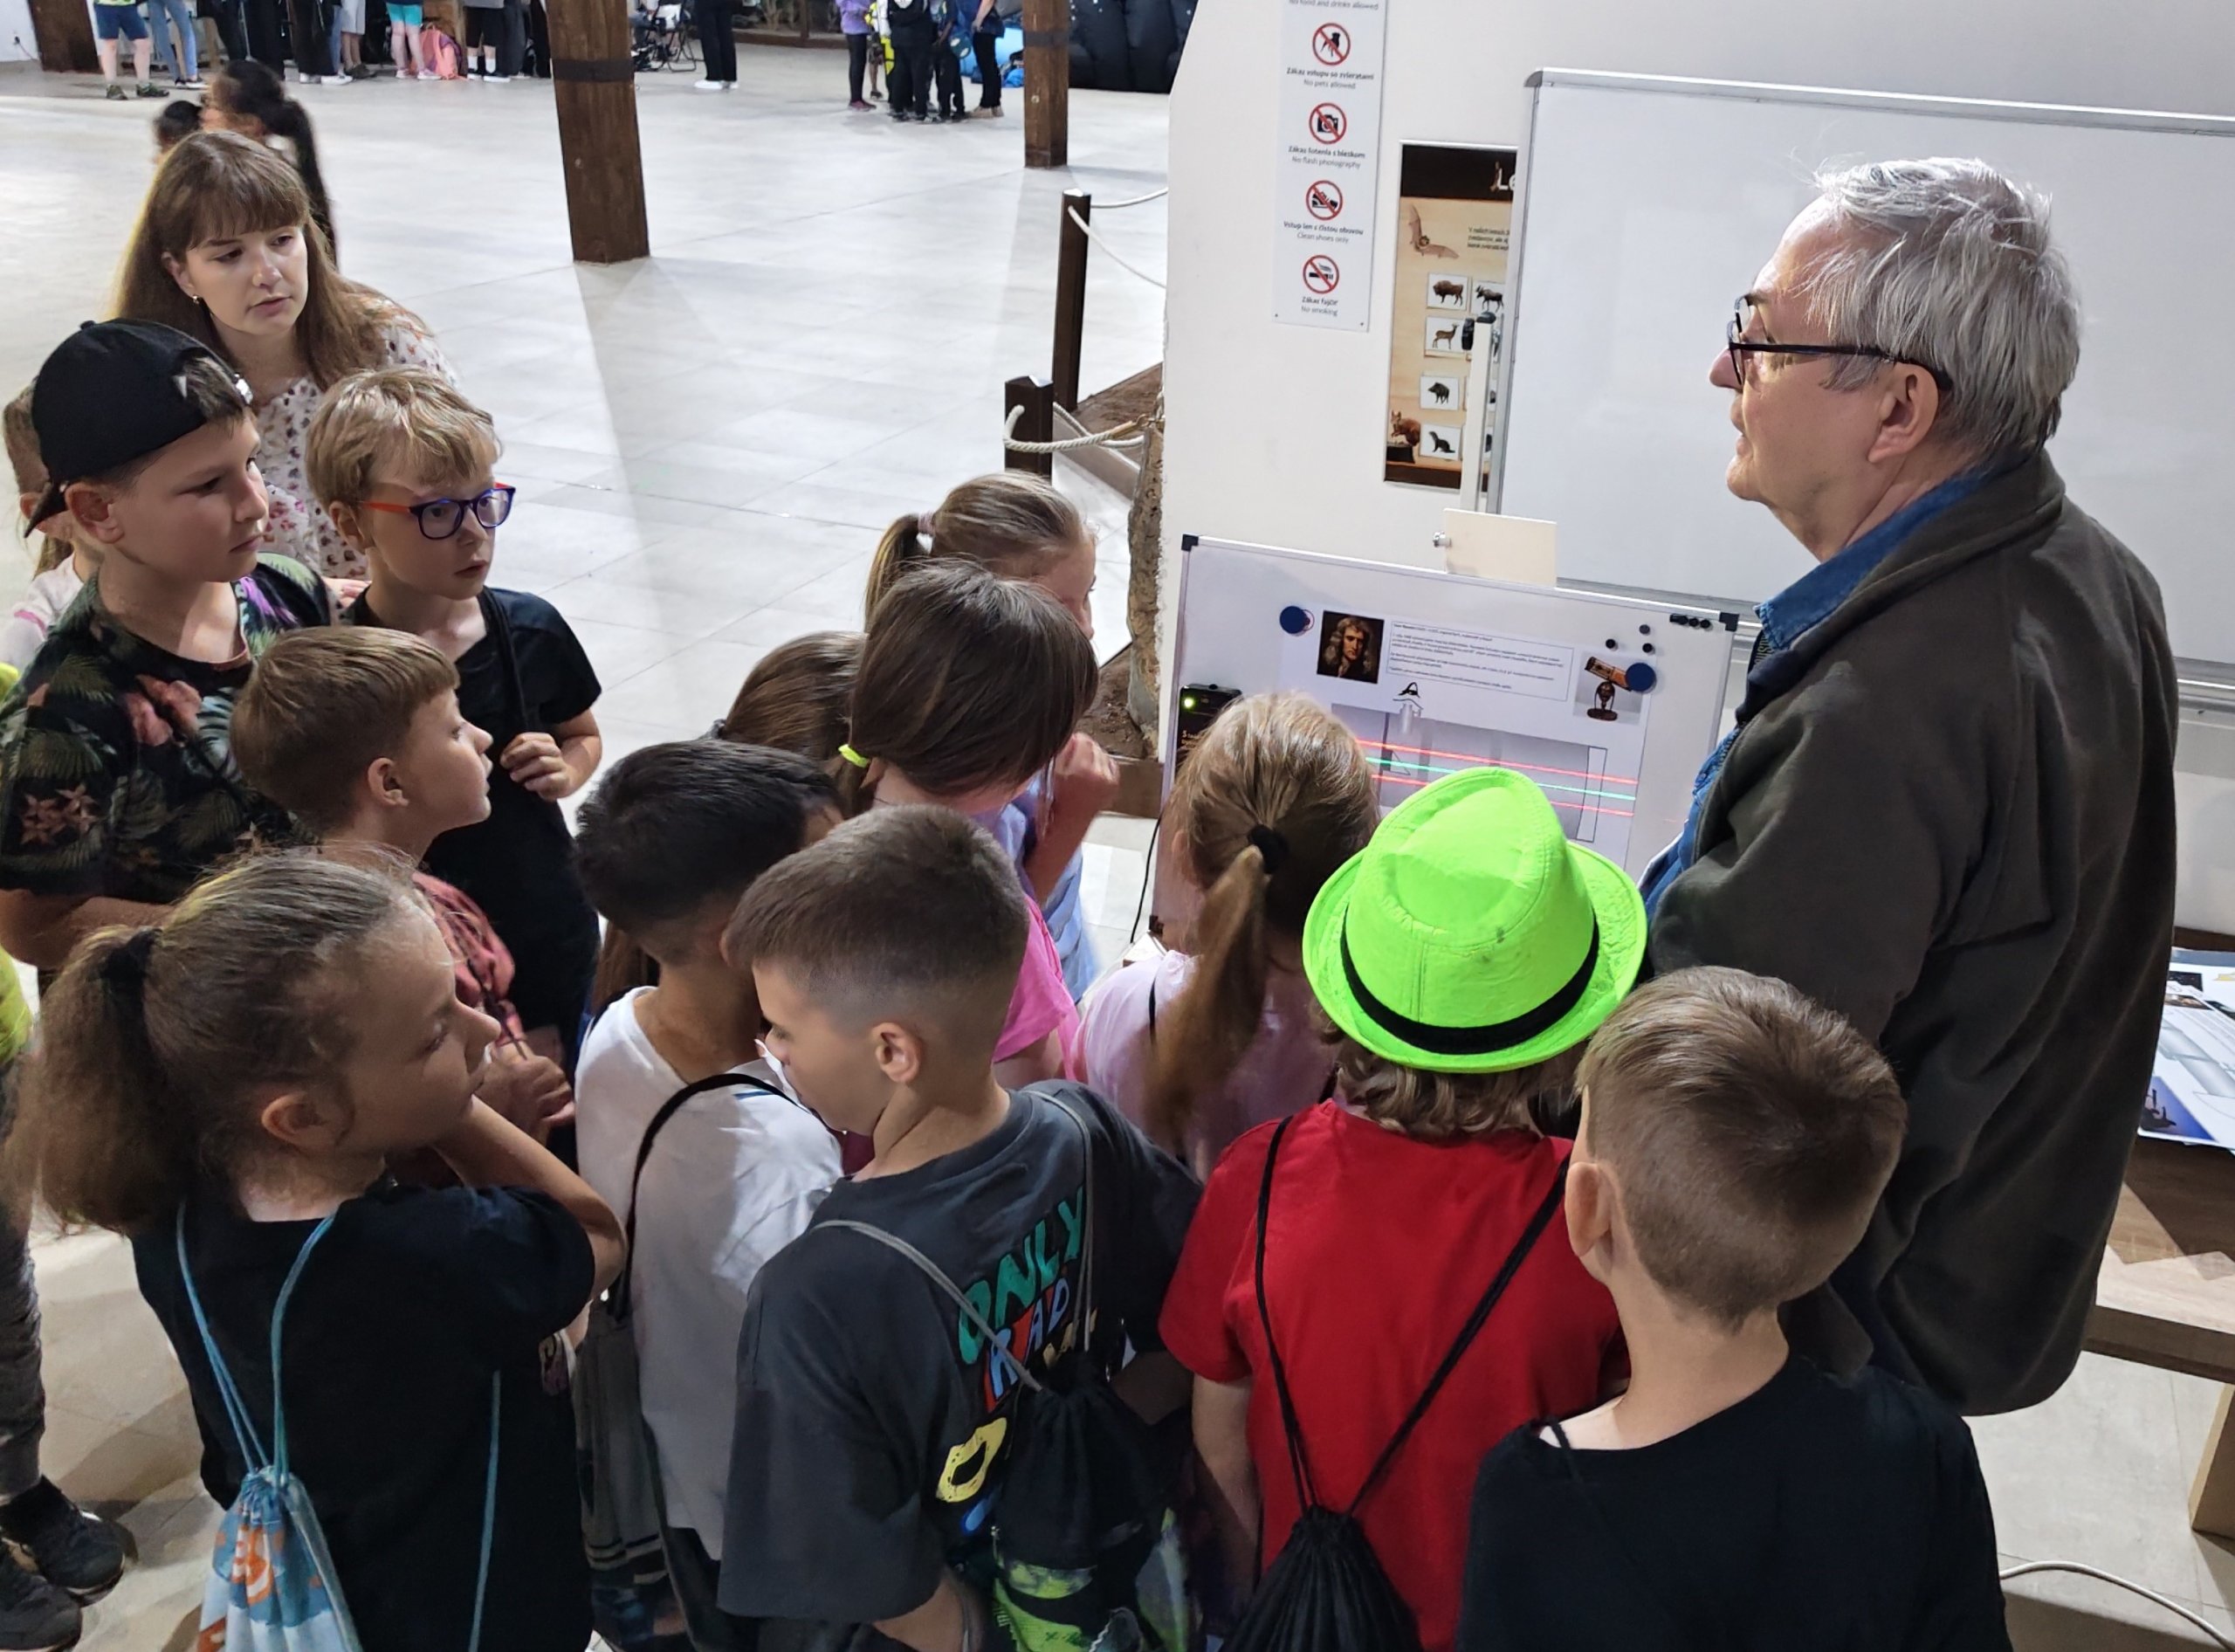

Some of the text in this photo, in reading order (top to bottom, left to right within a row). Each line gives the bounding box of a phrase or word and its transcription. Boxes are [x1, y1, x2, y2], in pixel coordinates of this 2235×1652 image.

[1302, 156, 1317, 165] flash
[1318, 158, 1361, 169] photography
[1283, 221, 1302, 230] Vstup
[1311, 307, 1338, 317] smoking
[958, 1185, 1083, 1365] ONLY
